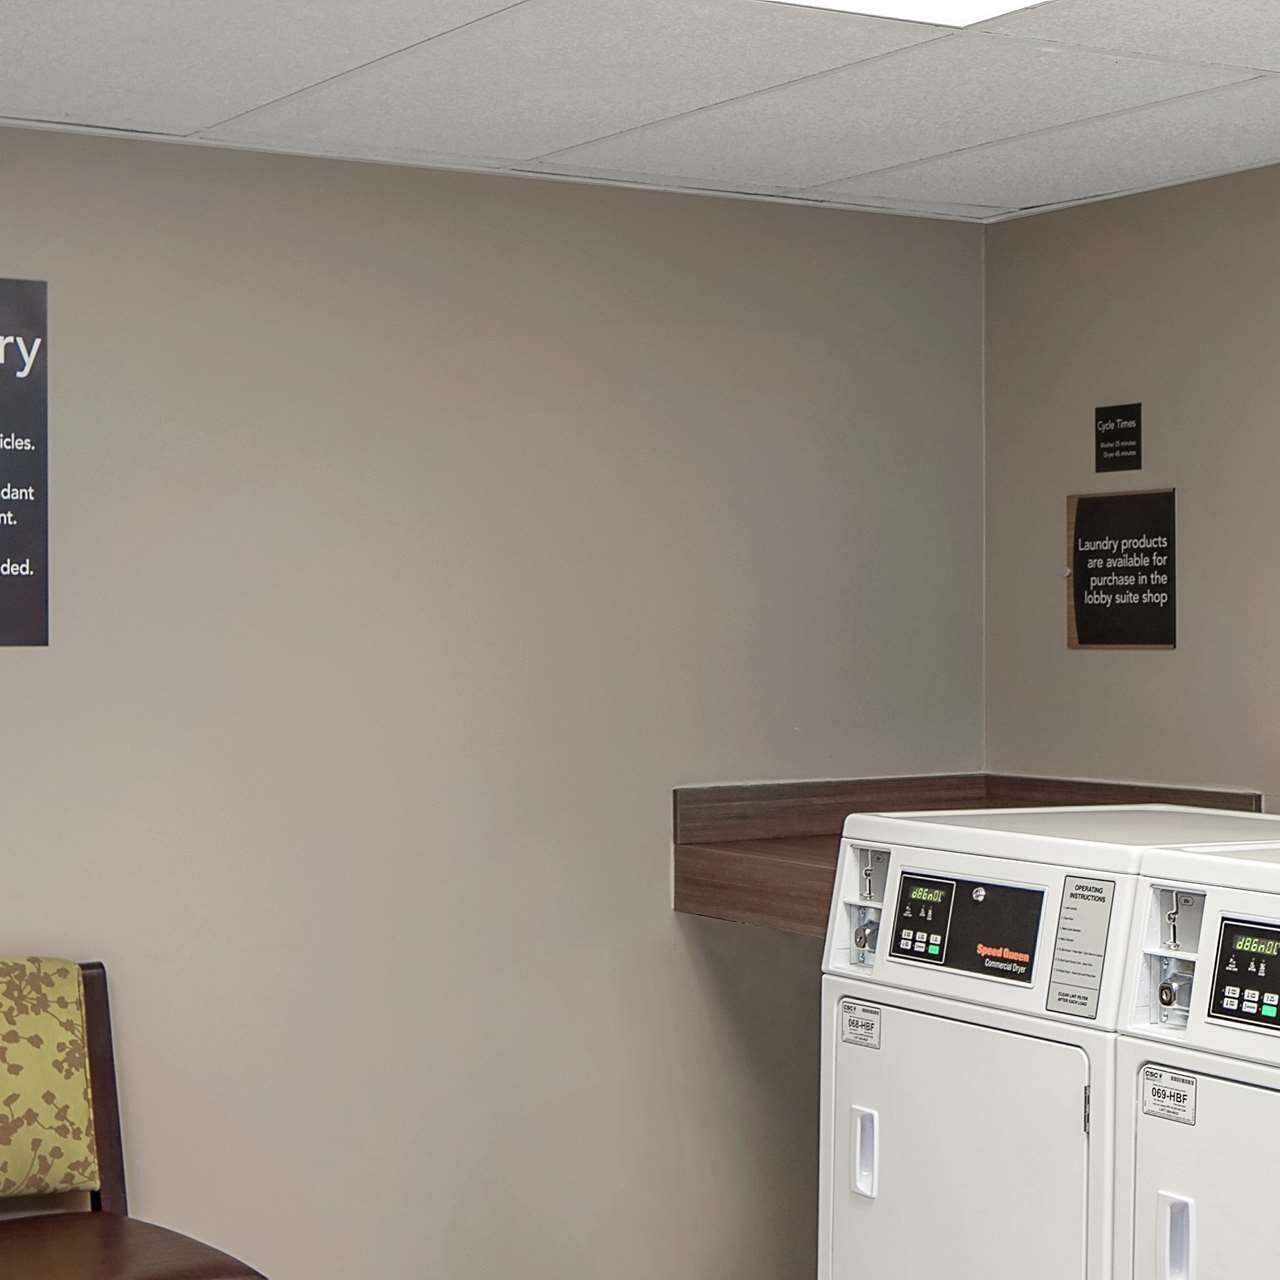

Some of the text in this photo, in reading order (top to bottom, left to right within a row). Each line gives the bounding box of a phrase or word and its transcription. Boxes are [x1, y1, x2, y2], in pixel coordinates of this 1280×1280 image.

[1078, 534, 1168, 554] Laundry products
[1087, 551, 1168, 568] are available for
[1090, 570, 1168, 590] purchase in the
[1084, 589, 1168, 608] lobby suite shop
[1075, 884, 1103, 894] OPERATING
[1070, 893, 1106, 903] INSTRUCTIONS
[977, 944, 1030, 962] Speed Queen
[985, 958, 1026, 974] Commercial Dryer
[1152, 1087, 1188, 1103] 069-HBF
